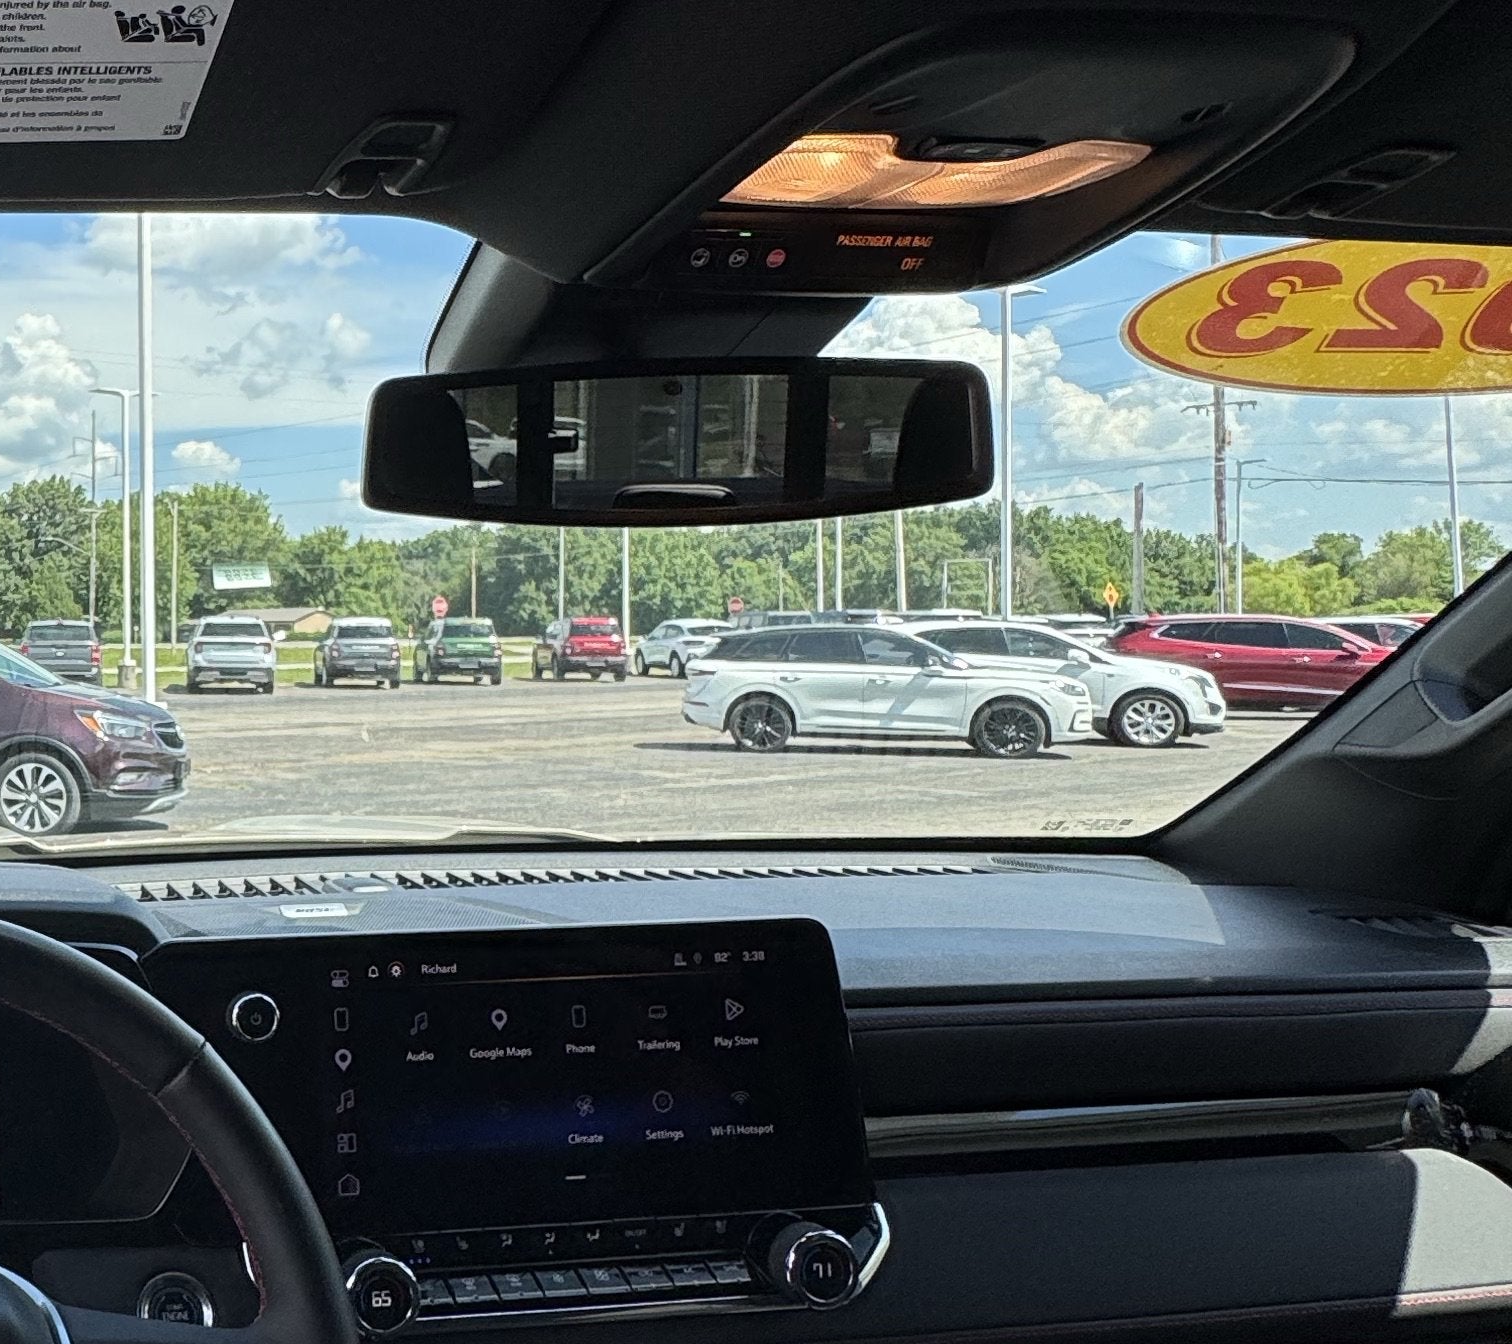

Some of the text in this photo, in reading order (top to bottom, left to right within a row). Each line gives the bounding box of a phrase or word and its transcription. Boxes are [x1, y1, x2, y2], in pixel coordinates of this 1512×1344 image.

[38, 1, 50, 10] by
[72, 0, 87, 7] air
[2, 12, 47, 20] children.
[19, 23, 46, 31] front.
[51, 45, 82, 53] about
[57, 66, 153, 76] INTELLIGENTS
[836, 234, 935, 248] PASSENGER AIR BAG
[899, 256, 925, 272] OFF
[420, 962, 457, 975] Richard
[565, 1043, 596, 1054] Phone
[638, 1039, 681, 1052] Trailering
[713, 1035, 759, 1049] Play Store
[405, 1051, 435, 1062] Audio
[469, 1046, 533, 1060] Google Maps
[645, 1129, 684, 1142] Settings
[710, 1123, 774, 1136] Wi-Fi Hotspot
[568, 1133, 604, 1144] Climate
[812, 1262, 832, 1279] 71
[371, 1290, 392, 1308] 65
